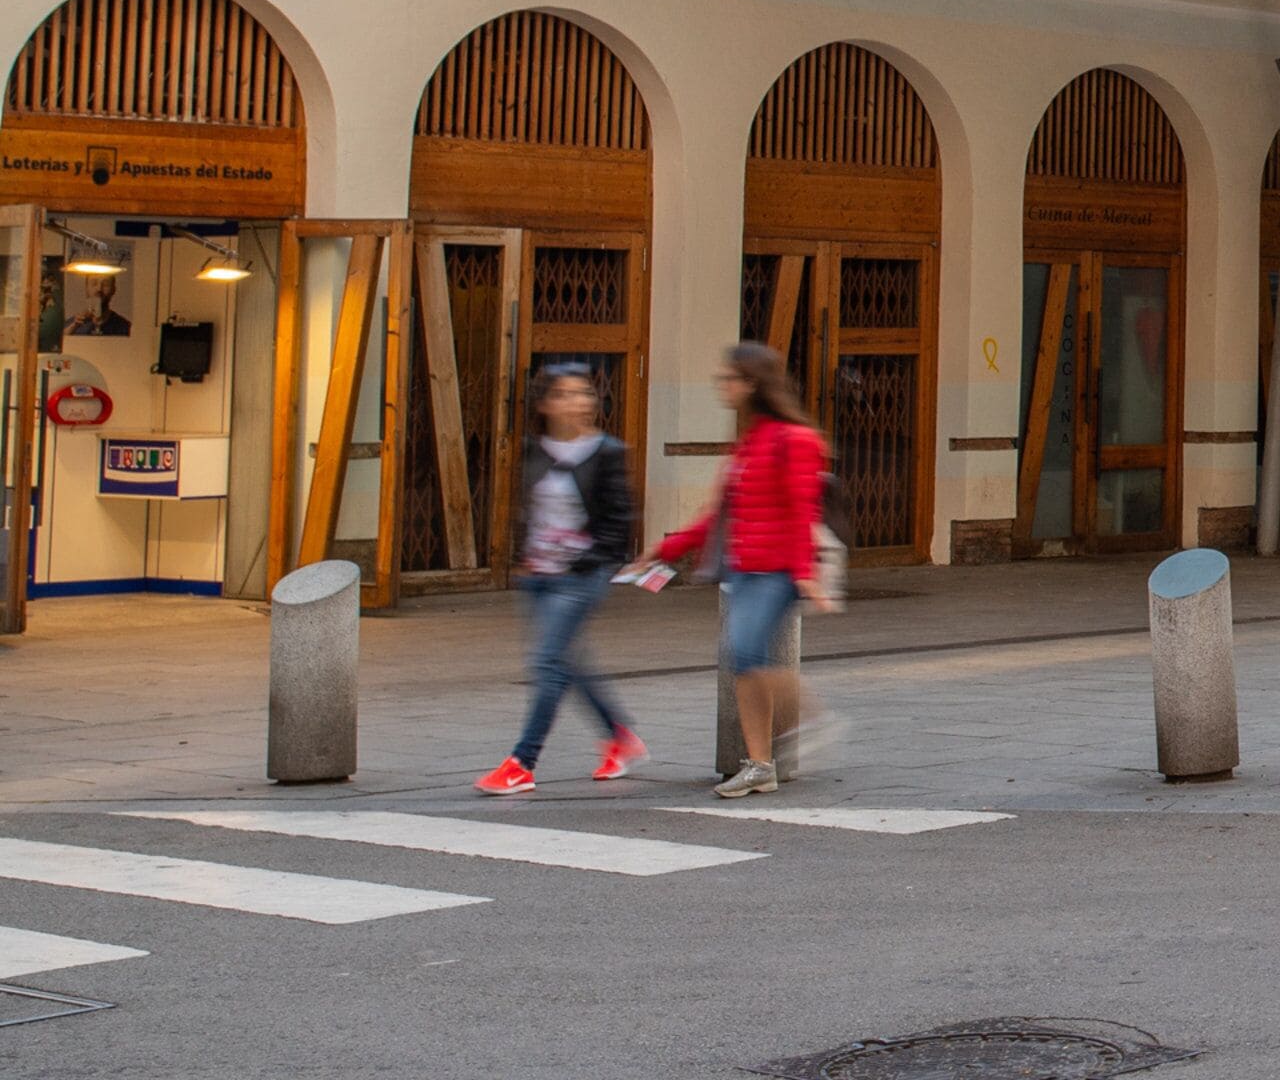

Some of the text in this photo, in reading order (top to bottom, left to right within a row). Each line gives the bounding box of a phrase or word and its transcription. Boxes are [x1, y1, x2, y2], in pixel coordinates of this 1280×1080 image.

[121, 162, 191, 177] Apuestas
[195, 164, 218, 178] del
[222, 166, 273, 180] Estado
